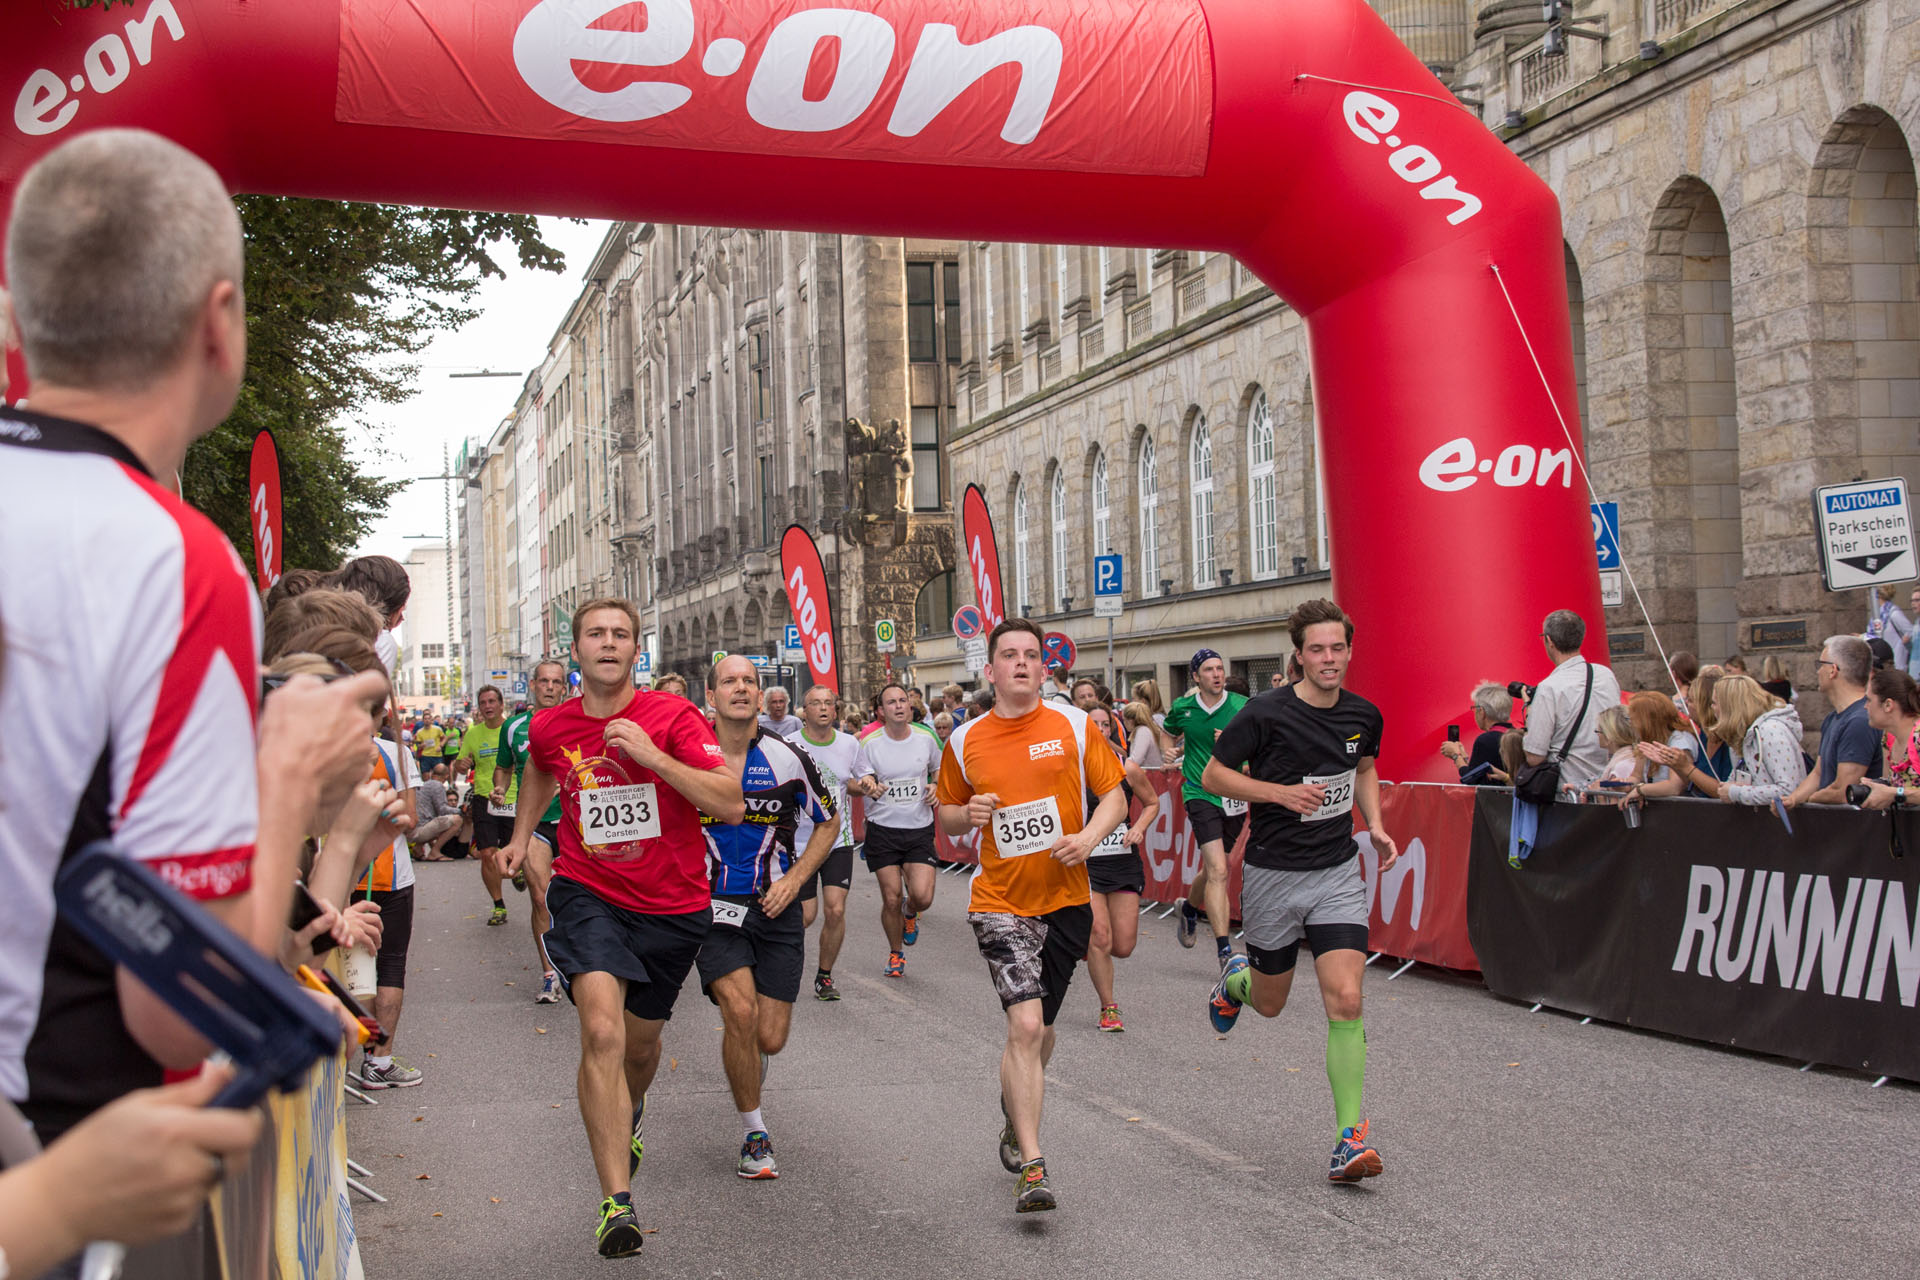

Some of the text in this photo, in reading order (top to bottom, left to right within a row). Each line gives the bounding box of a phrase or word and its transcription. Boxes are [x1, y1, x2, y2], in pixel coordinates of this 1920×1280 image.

[1831, 489, 1897, 512] AUTOMAT
[1828, 514, 1906, 536] Parkschein
[1831, 535, 1908, 554] hier lösen
[1098, 560, 1115, 591] P
[788, 627, 800, 647] P
[881, 626, 890, 638] H
[637, 654, 646, 670] P
[1345, 742, 1359, 754] EY
[601, 792, 647, 803] ALSTERLAUF
[888, 785, 918, 798] 4112
[1322, 784, 1350, 807] 622
[588, 801, 651, 829] 2033
[1008, 806, 1049, 820] ALSTERLAUF
[1321, 808, 1339, 816] Lukas
[605, 829, 639, 838] Carsten
[999, 814, 1055, 843] 3569
[1016, 840, 1044, 852] Steffen
[1672, 864, 1920, 1008] RUNNIN
